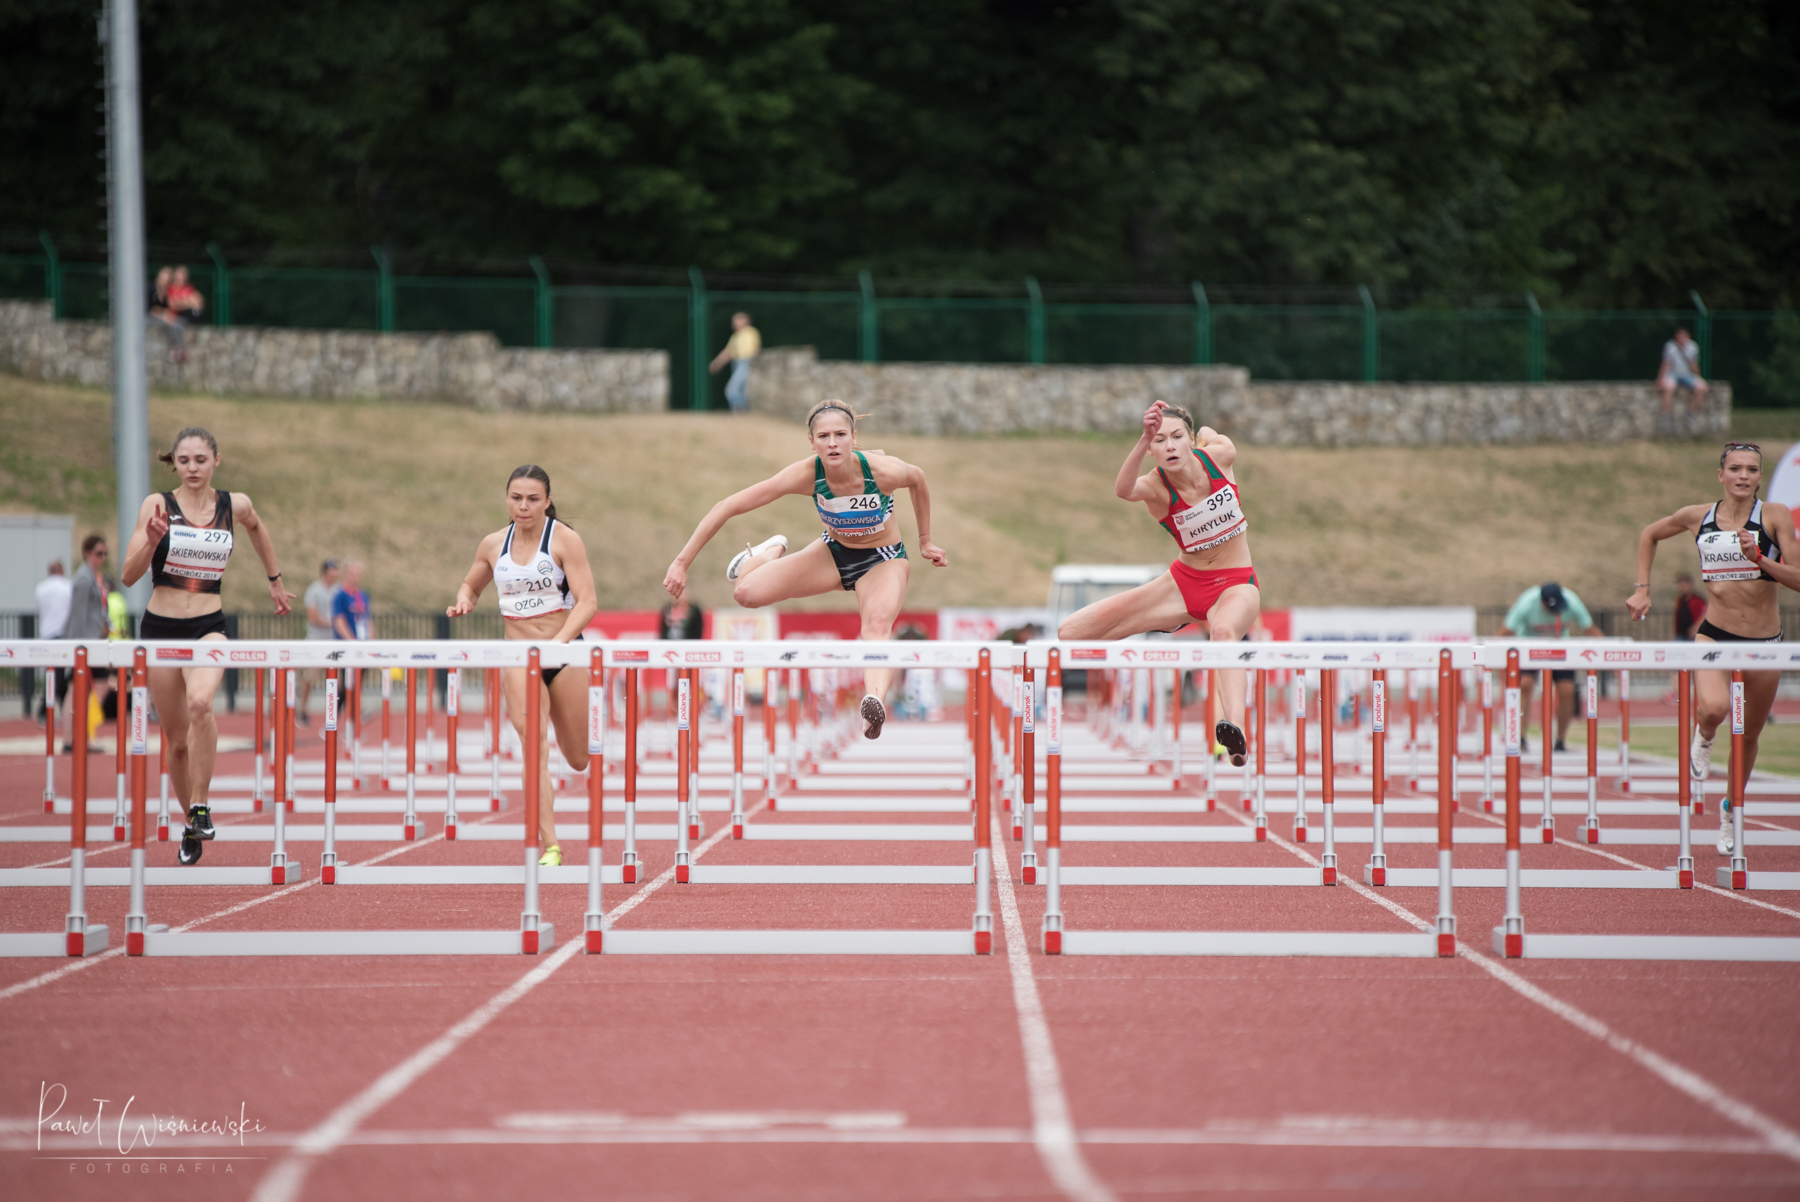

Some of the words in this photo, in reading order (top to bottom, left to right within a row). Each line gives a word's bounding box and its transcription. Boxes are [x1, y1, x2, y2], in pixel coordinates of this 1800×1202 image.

[849, 497, 878, 510] 246
[1206, 488, 1233, 511] 395
[1189, 510, 1236, 538] KIRYLUK
[204, 531, 229, 544] 297
[1227, 527, 1241, 540] 2019
[1703, 534, 1721, 544] 4F
[170, 547, 227, 562] SKIERKOWSKA
[1704, 552, 1749, 563] KRASICK
[170, 567, 202, 578] RACIBÓRZ
[1706, 572, 1738, 581] RACIBÓRZ
[1739, 572, 1753, 580] 2019
[526, 577, 552, 592] 210
[514, 597, 545, 611] OZGA
[231, 651, 265, 660] ORLEN
[686, 652, 720, 661] ORLEN
[1144, 651, 1178, 661] ORLEN
[1605, 652, 1640, 661] ORLEN
[1734, 695, 1743, 724] polanik
[591, 703, 599, 741] polanik
[1510, 707, 1518, 743] polanik
